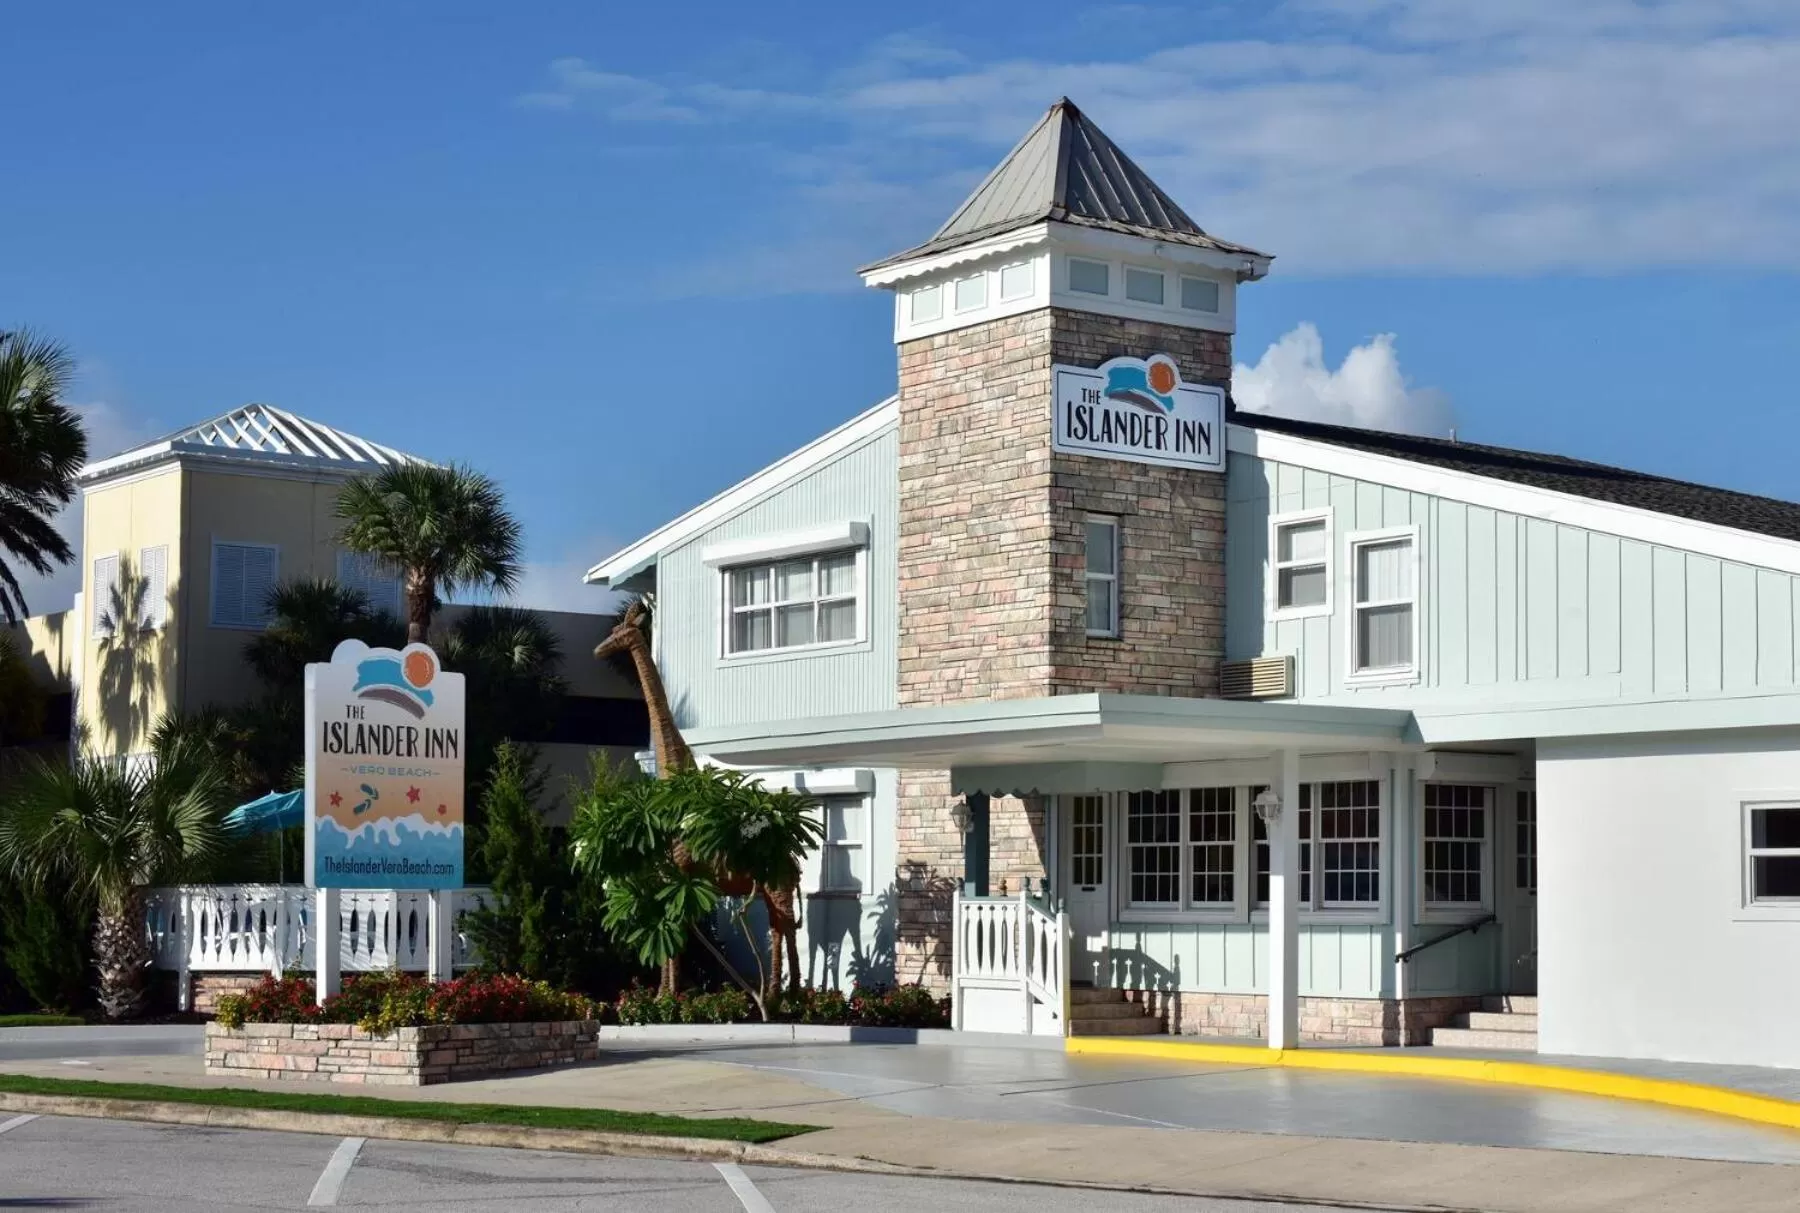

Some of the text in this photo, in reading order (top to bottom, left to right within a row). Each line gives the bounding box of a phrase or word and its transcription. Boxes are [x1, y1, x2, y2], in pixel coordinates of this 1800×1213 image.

[1081, 388, 1101, 405] THE
[1067, 401, 1211, 455] ISLANDER INN
[345, 704, 365, 720] THE
[323, 721, 459, 759] ISLANDER INN
[350, 765, 432, 777] VERO BEACH
[324, 856, 455, 875] TheIslanderVeroBeach.com
